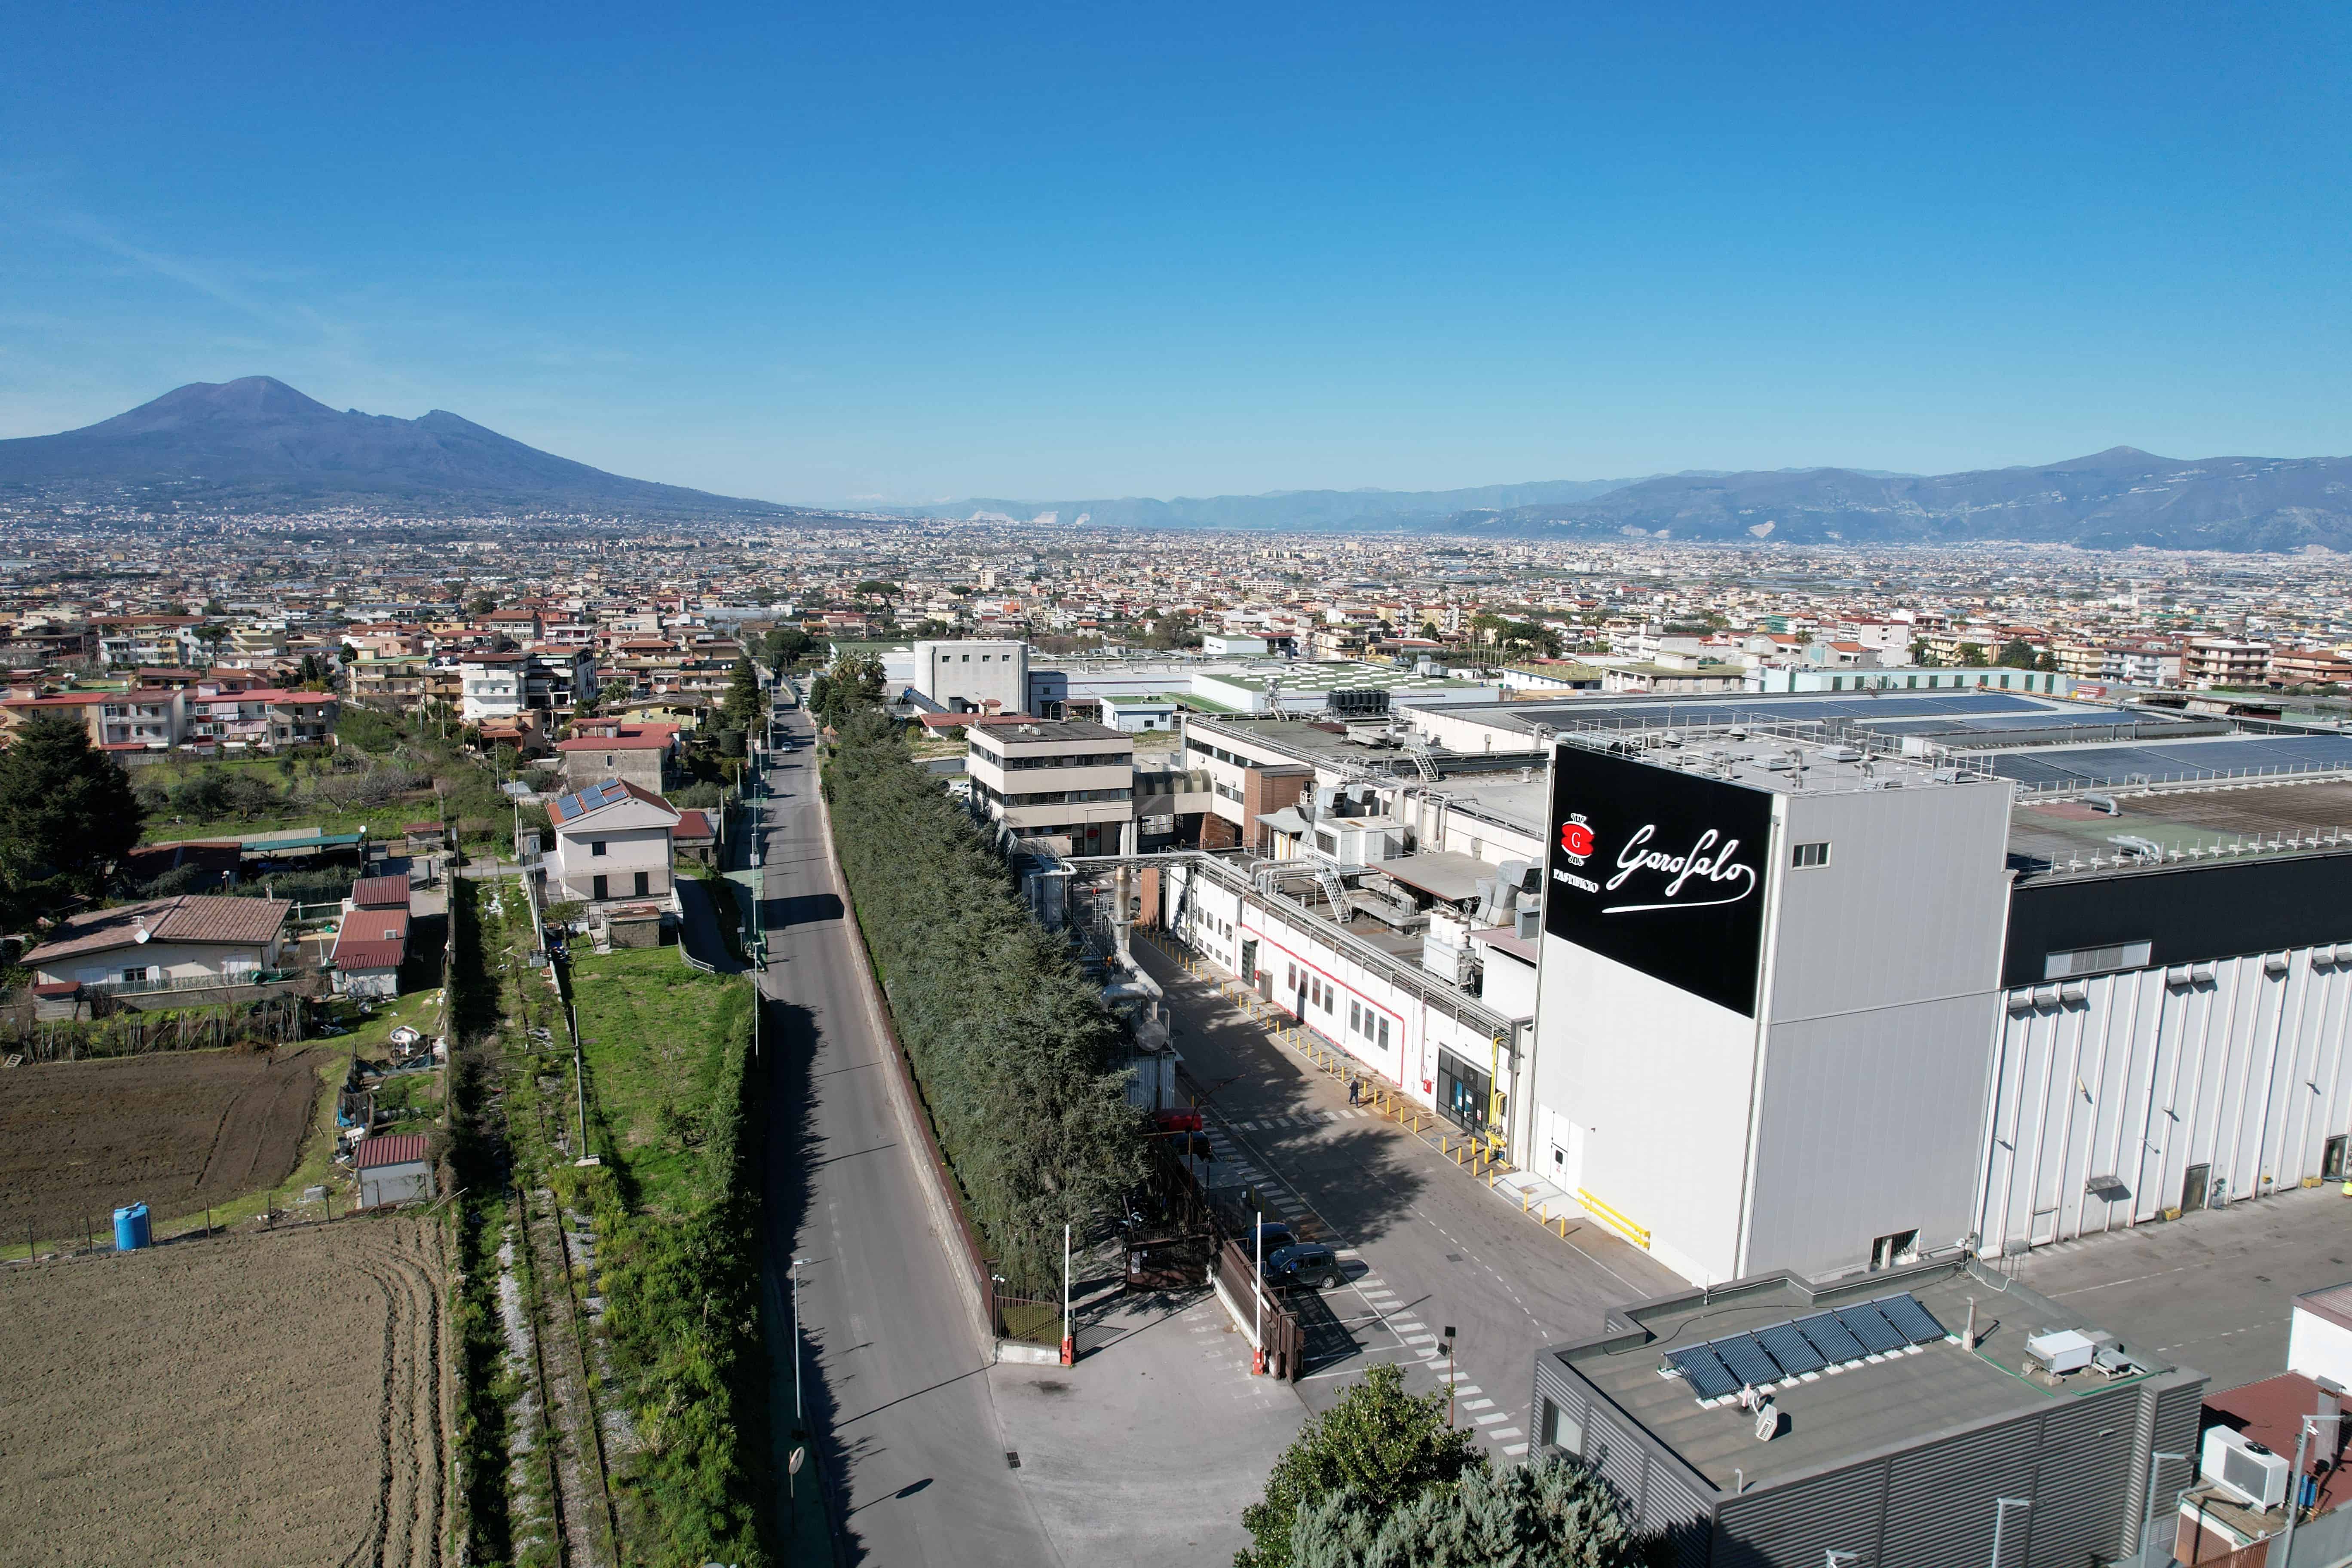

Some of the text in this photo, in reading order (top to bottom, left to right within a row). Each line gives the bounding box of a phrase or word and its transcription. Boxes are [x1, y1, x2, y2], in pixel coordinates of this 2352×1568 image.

[1571, 832, 1581, 848] G
[1606, 824, 1755, 897] Garofalo
[1553, 868, 1599, 893] PASTIFICIO
